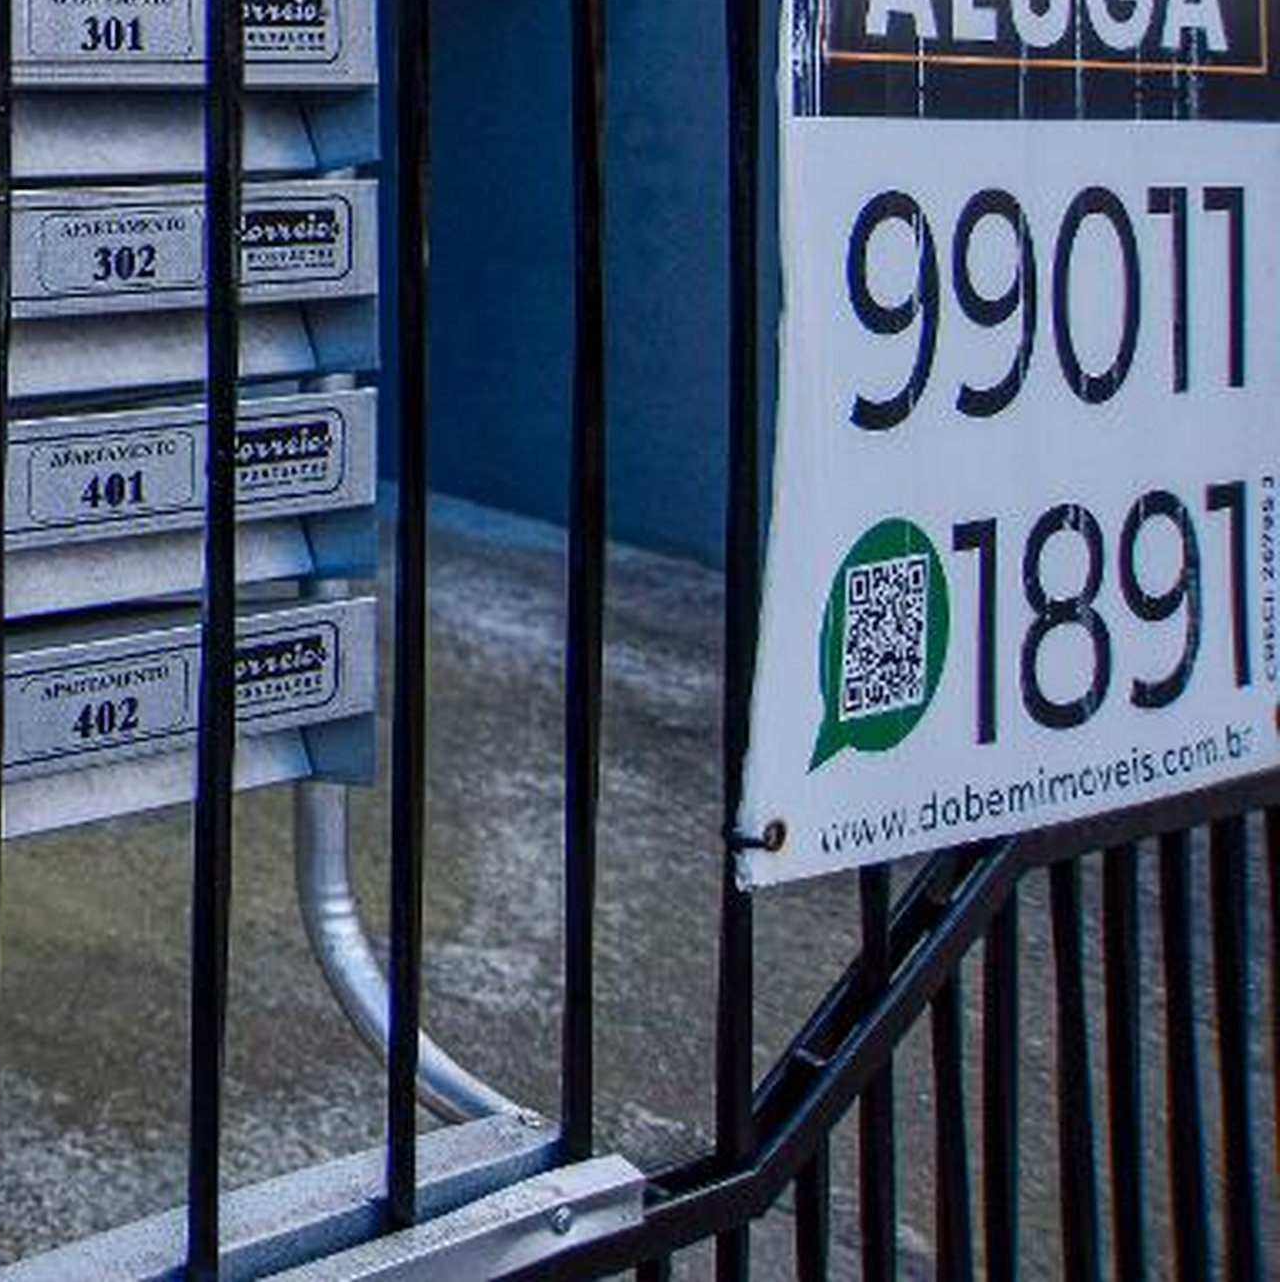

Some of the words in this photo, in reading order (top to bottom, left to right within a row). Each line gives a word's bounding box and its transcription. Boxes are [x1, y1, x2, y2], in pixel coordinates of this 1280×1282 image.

[81, 16, 145, 52] 301
[93, 244, 157, 282] 302
[846, 185, 1245, 431] 99011
[81, 470, 145, 508] 401
[952, 479, 1252, 745] 1891
[73, 696, 139, 739] 402
